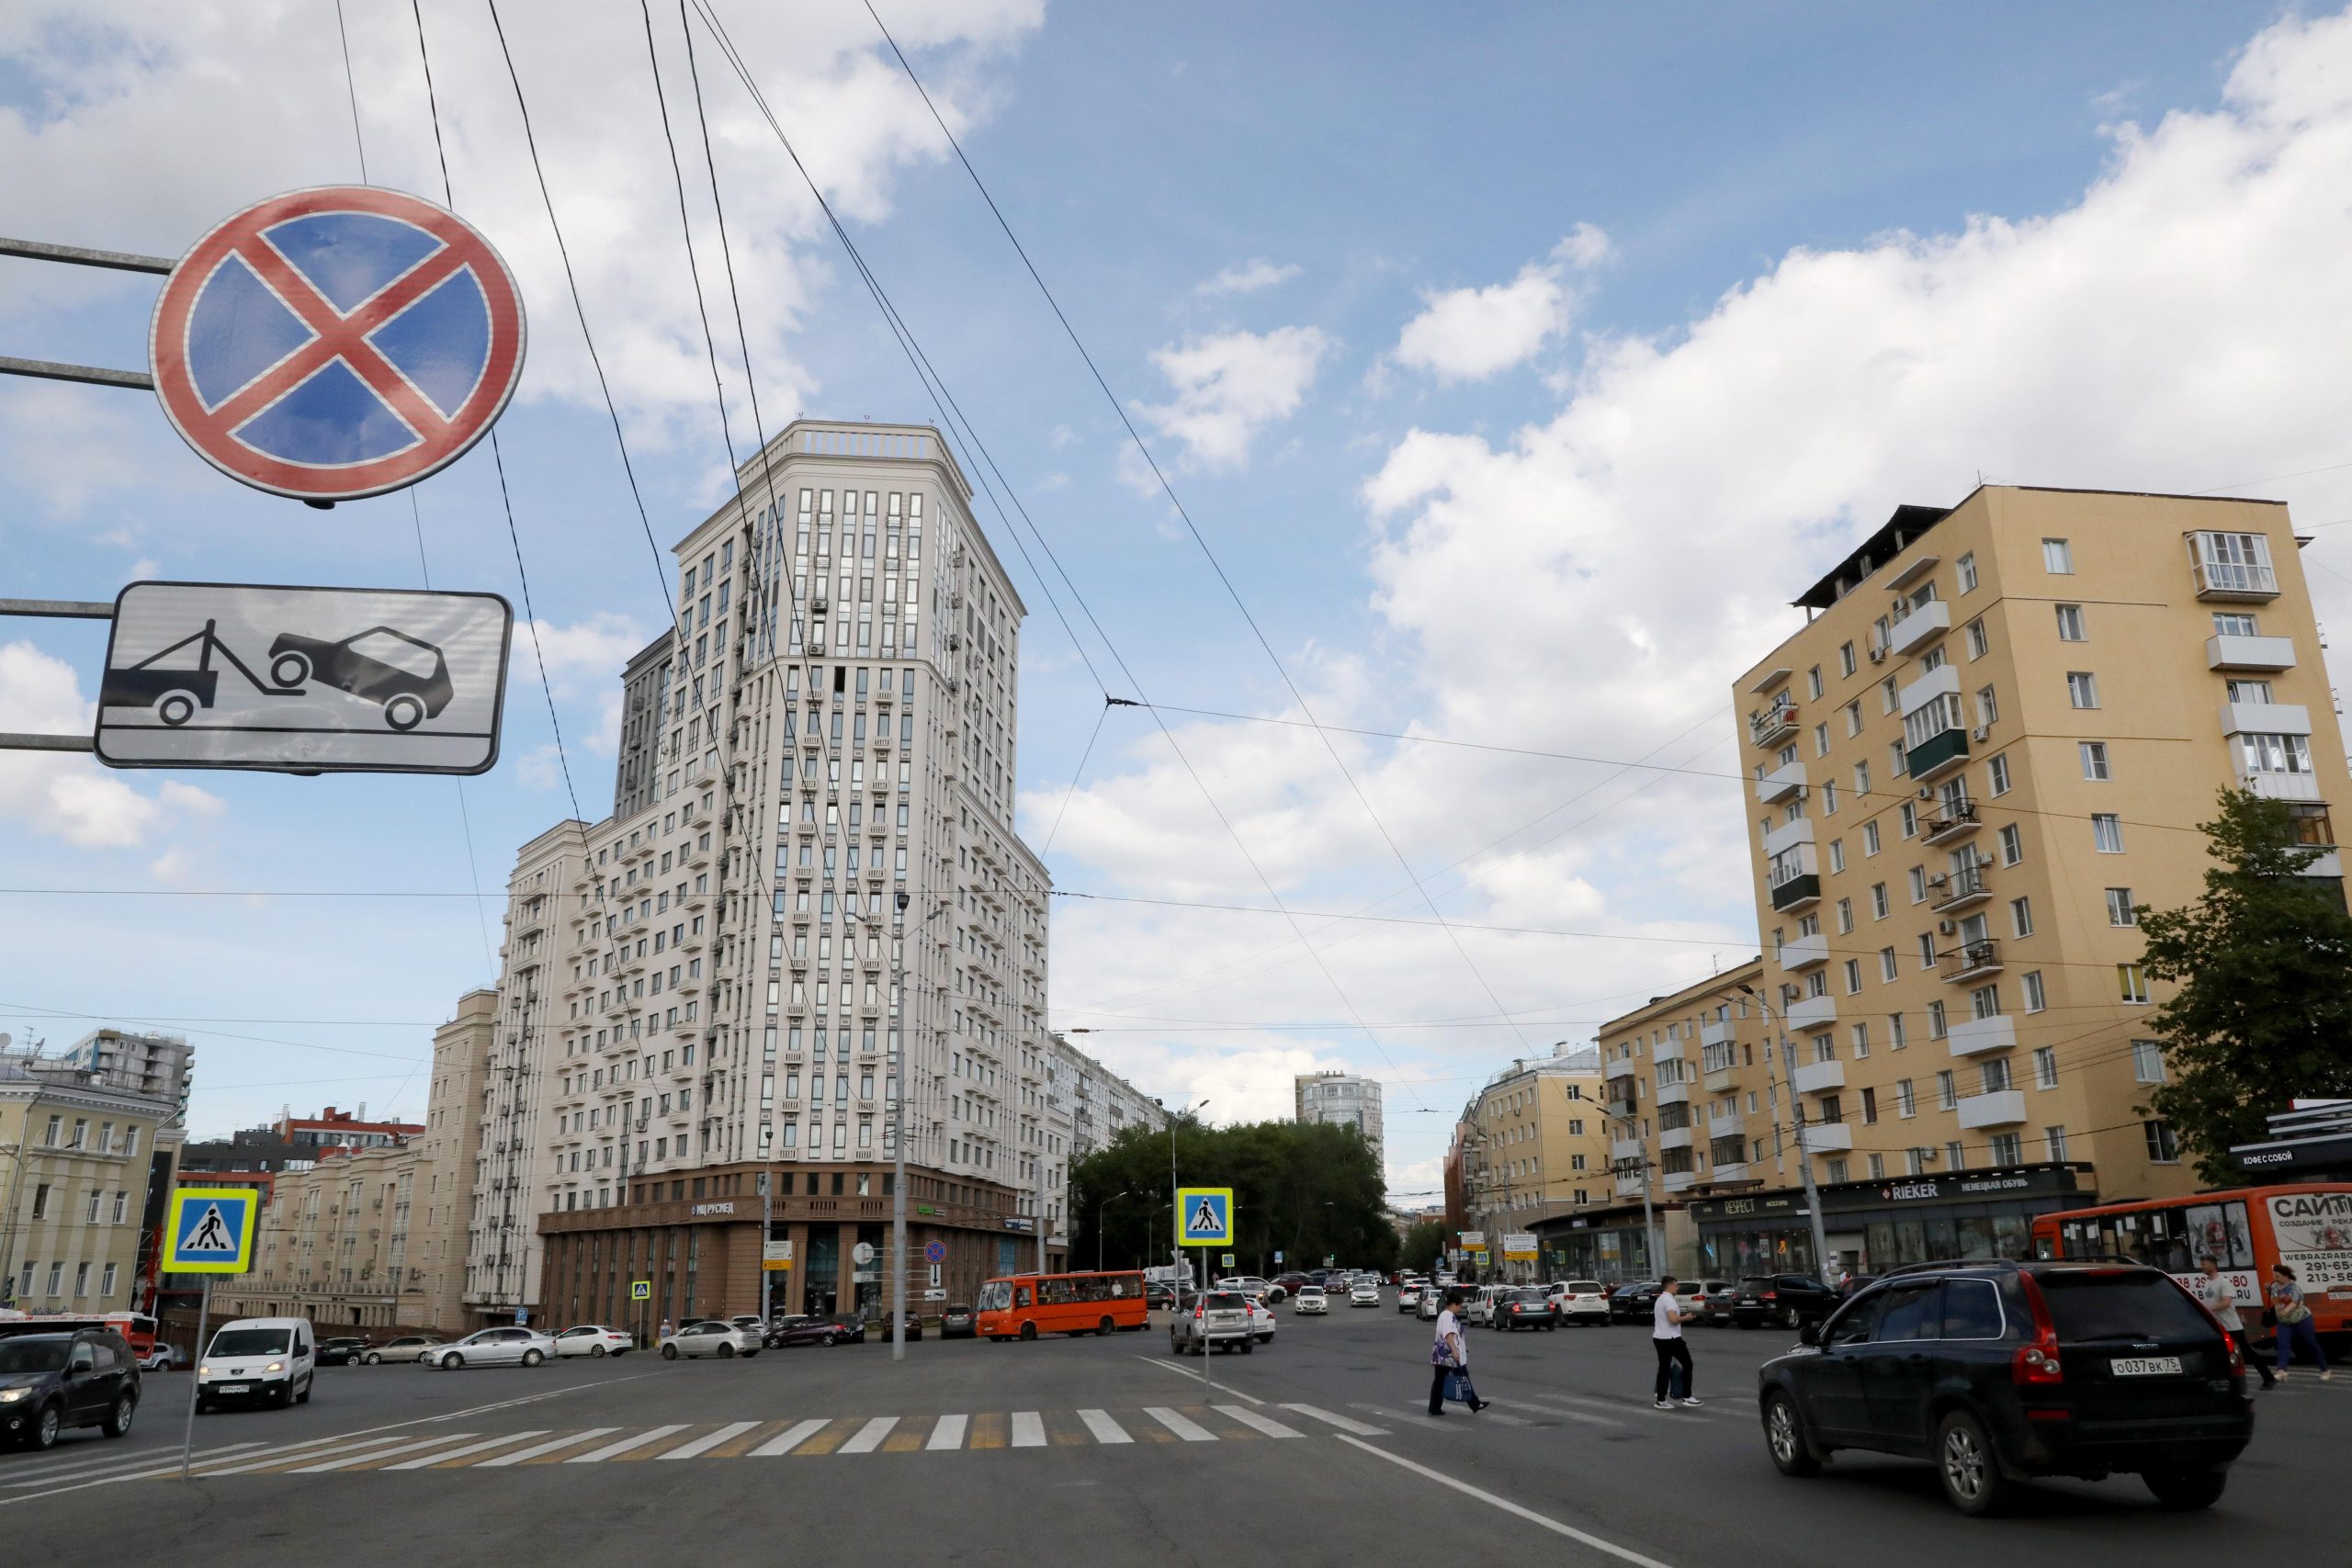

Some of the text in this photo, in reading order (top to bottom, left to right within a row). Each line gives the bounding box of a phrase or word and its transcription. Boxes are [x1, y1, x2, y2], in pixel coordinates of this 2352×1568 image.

[2244, 1156, 2262, 1165] КОФЕ
[2267, 1150, 2293, 1162] СОБОЙ
[1892, 1183, 1939, 1201] RIEKER
[1962, 1179, 2029, 1192] НЕМЕЦКАЯ ОБУВЬ
[1724, 1198, 1755, 1214] RESPECT
[2274, 1193, 2352, 1218] САЙТ
[2278, 1219, 2324, 1227] СОЗДАНИЕ
